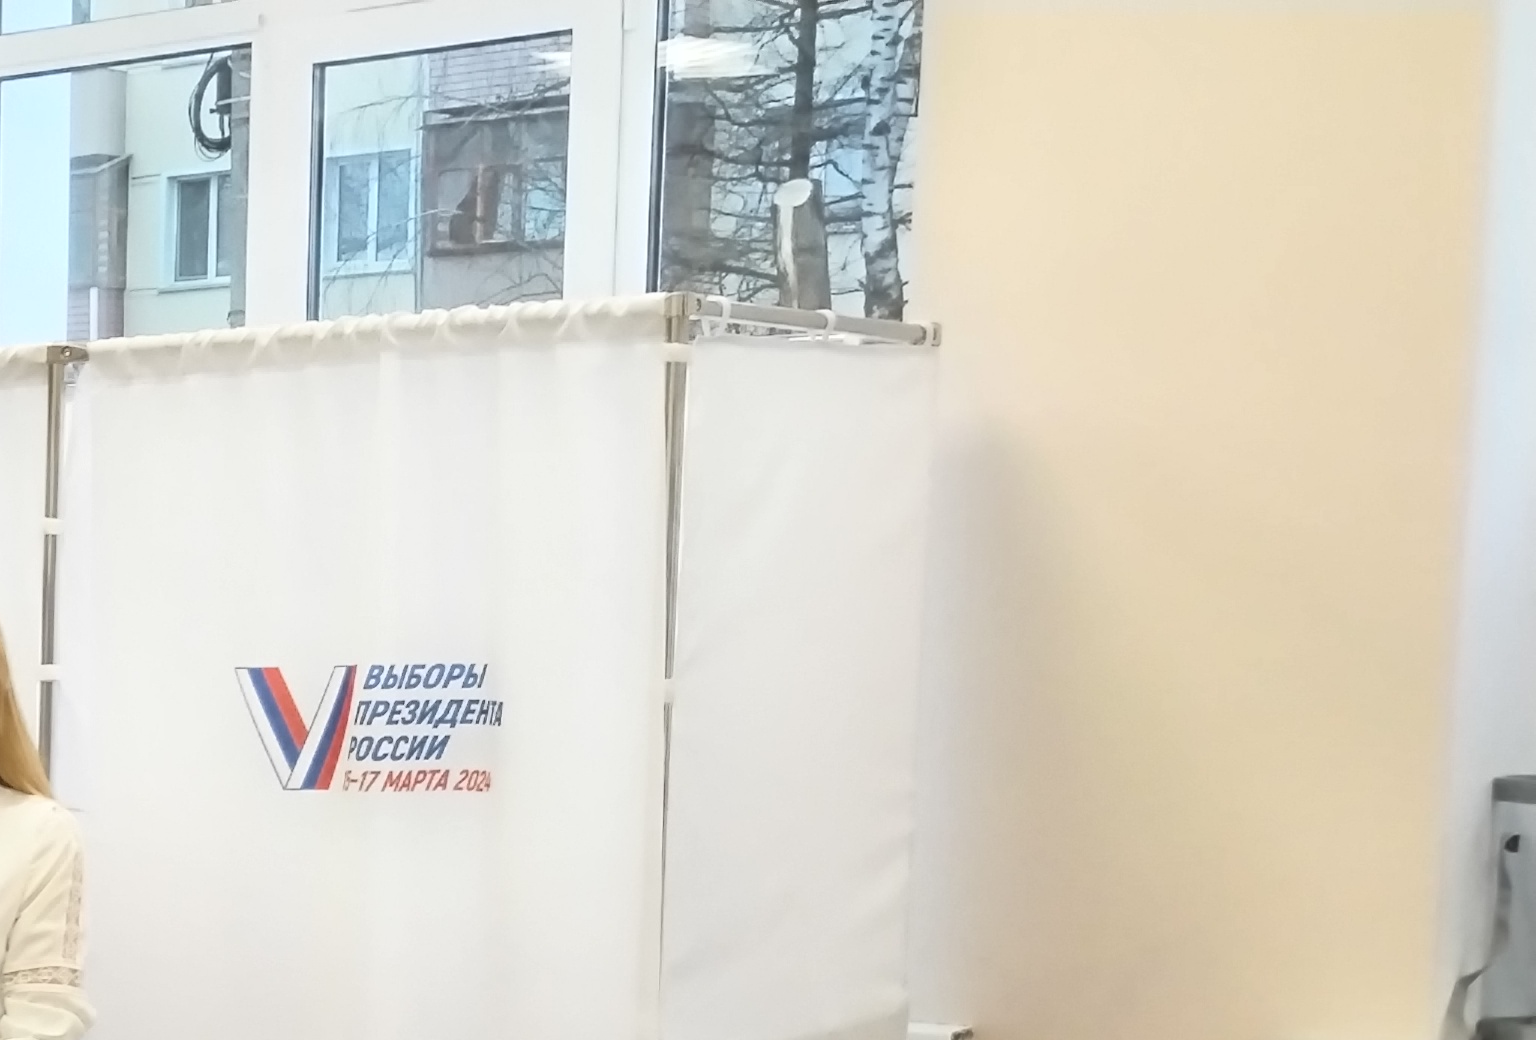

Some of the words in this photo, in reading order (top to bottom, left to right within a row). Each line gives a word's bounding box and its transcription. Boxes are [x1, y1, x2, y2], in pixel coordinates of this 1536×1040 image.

[362, 662, 488, 690] ВЫБОРЫ
[353, 699, 504, 729] ПРЕЗИДЕНТА
[347, 734, 451, 762] РОССИИ
[380, 768, 450, 793] МАРТА
[452, 768, 492, 792] 2024
